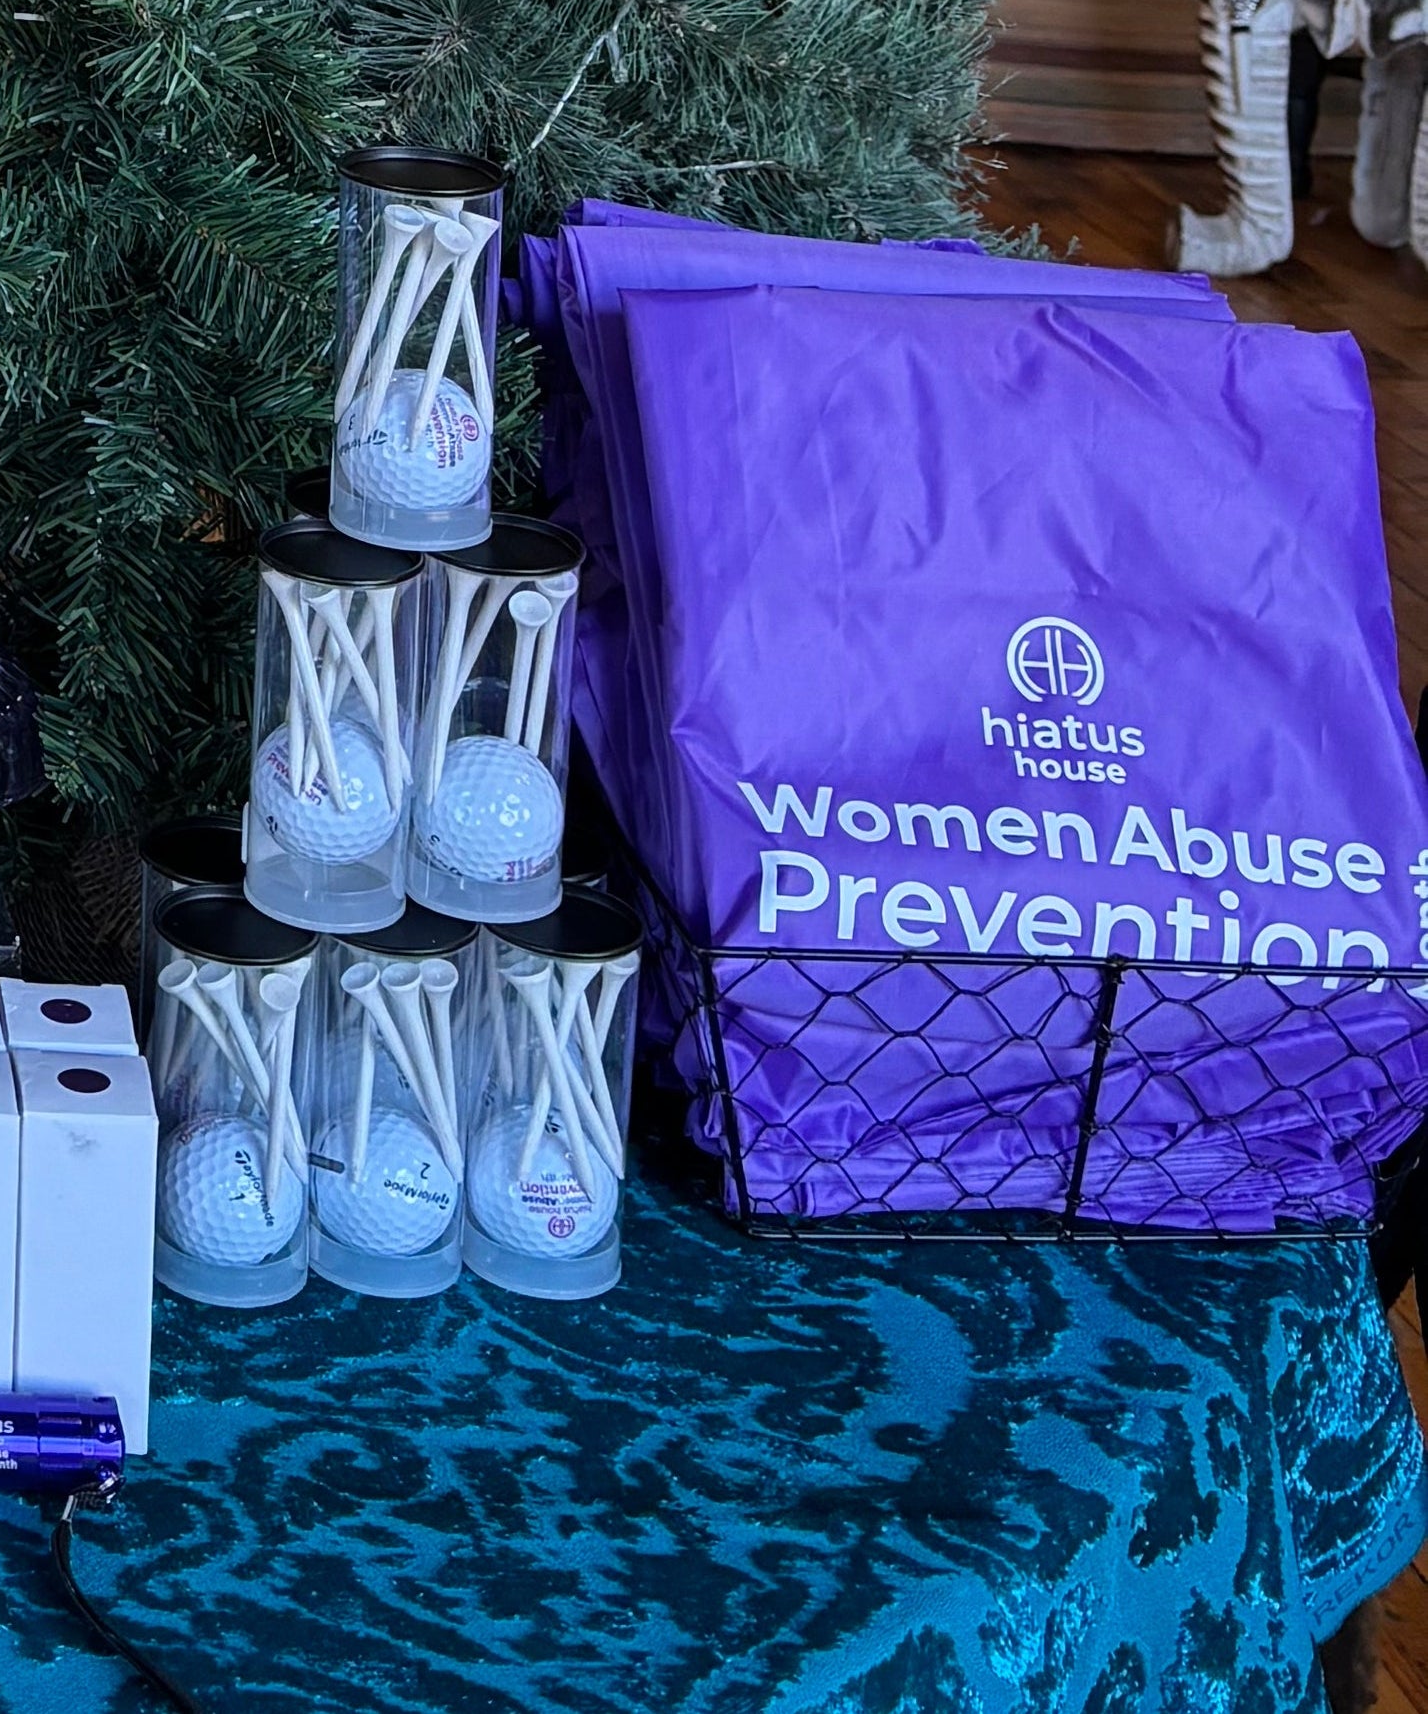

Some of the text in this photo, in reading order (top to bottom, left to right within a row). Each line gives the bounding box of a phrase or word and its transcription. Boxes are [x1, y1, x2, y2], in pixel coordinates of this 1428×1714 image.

[981, 707, 1145, 757] hiatus
[1015, 752, 1127, 785] house
[737, 781, 1385, 894] Women Abuse
[760, 850, 1389, 994] Prevention
[420, 1162, 431, 1179] 2
